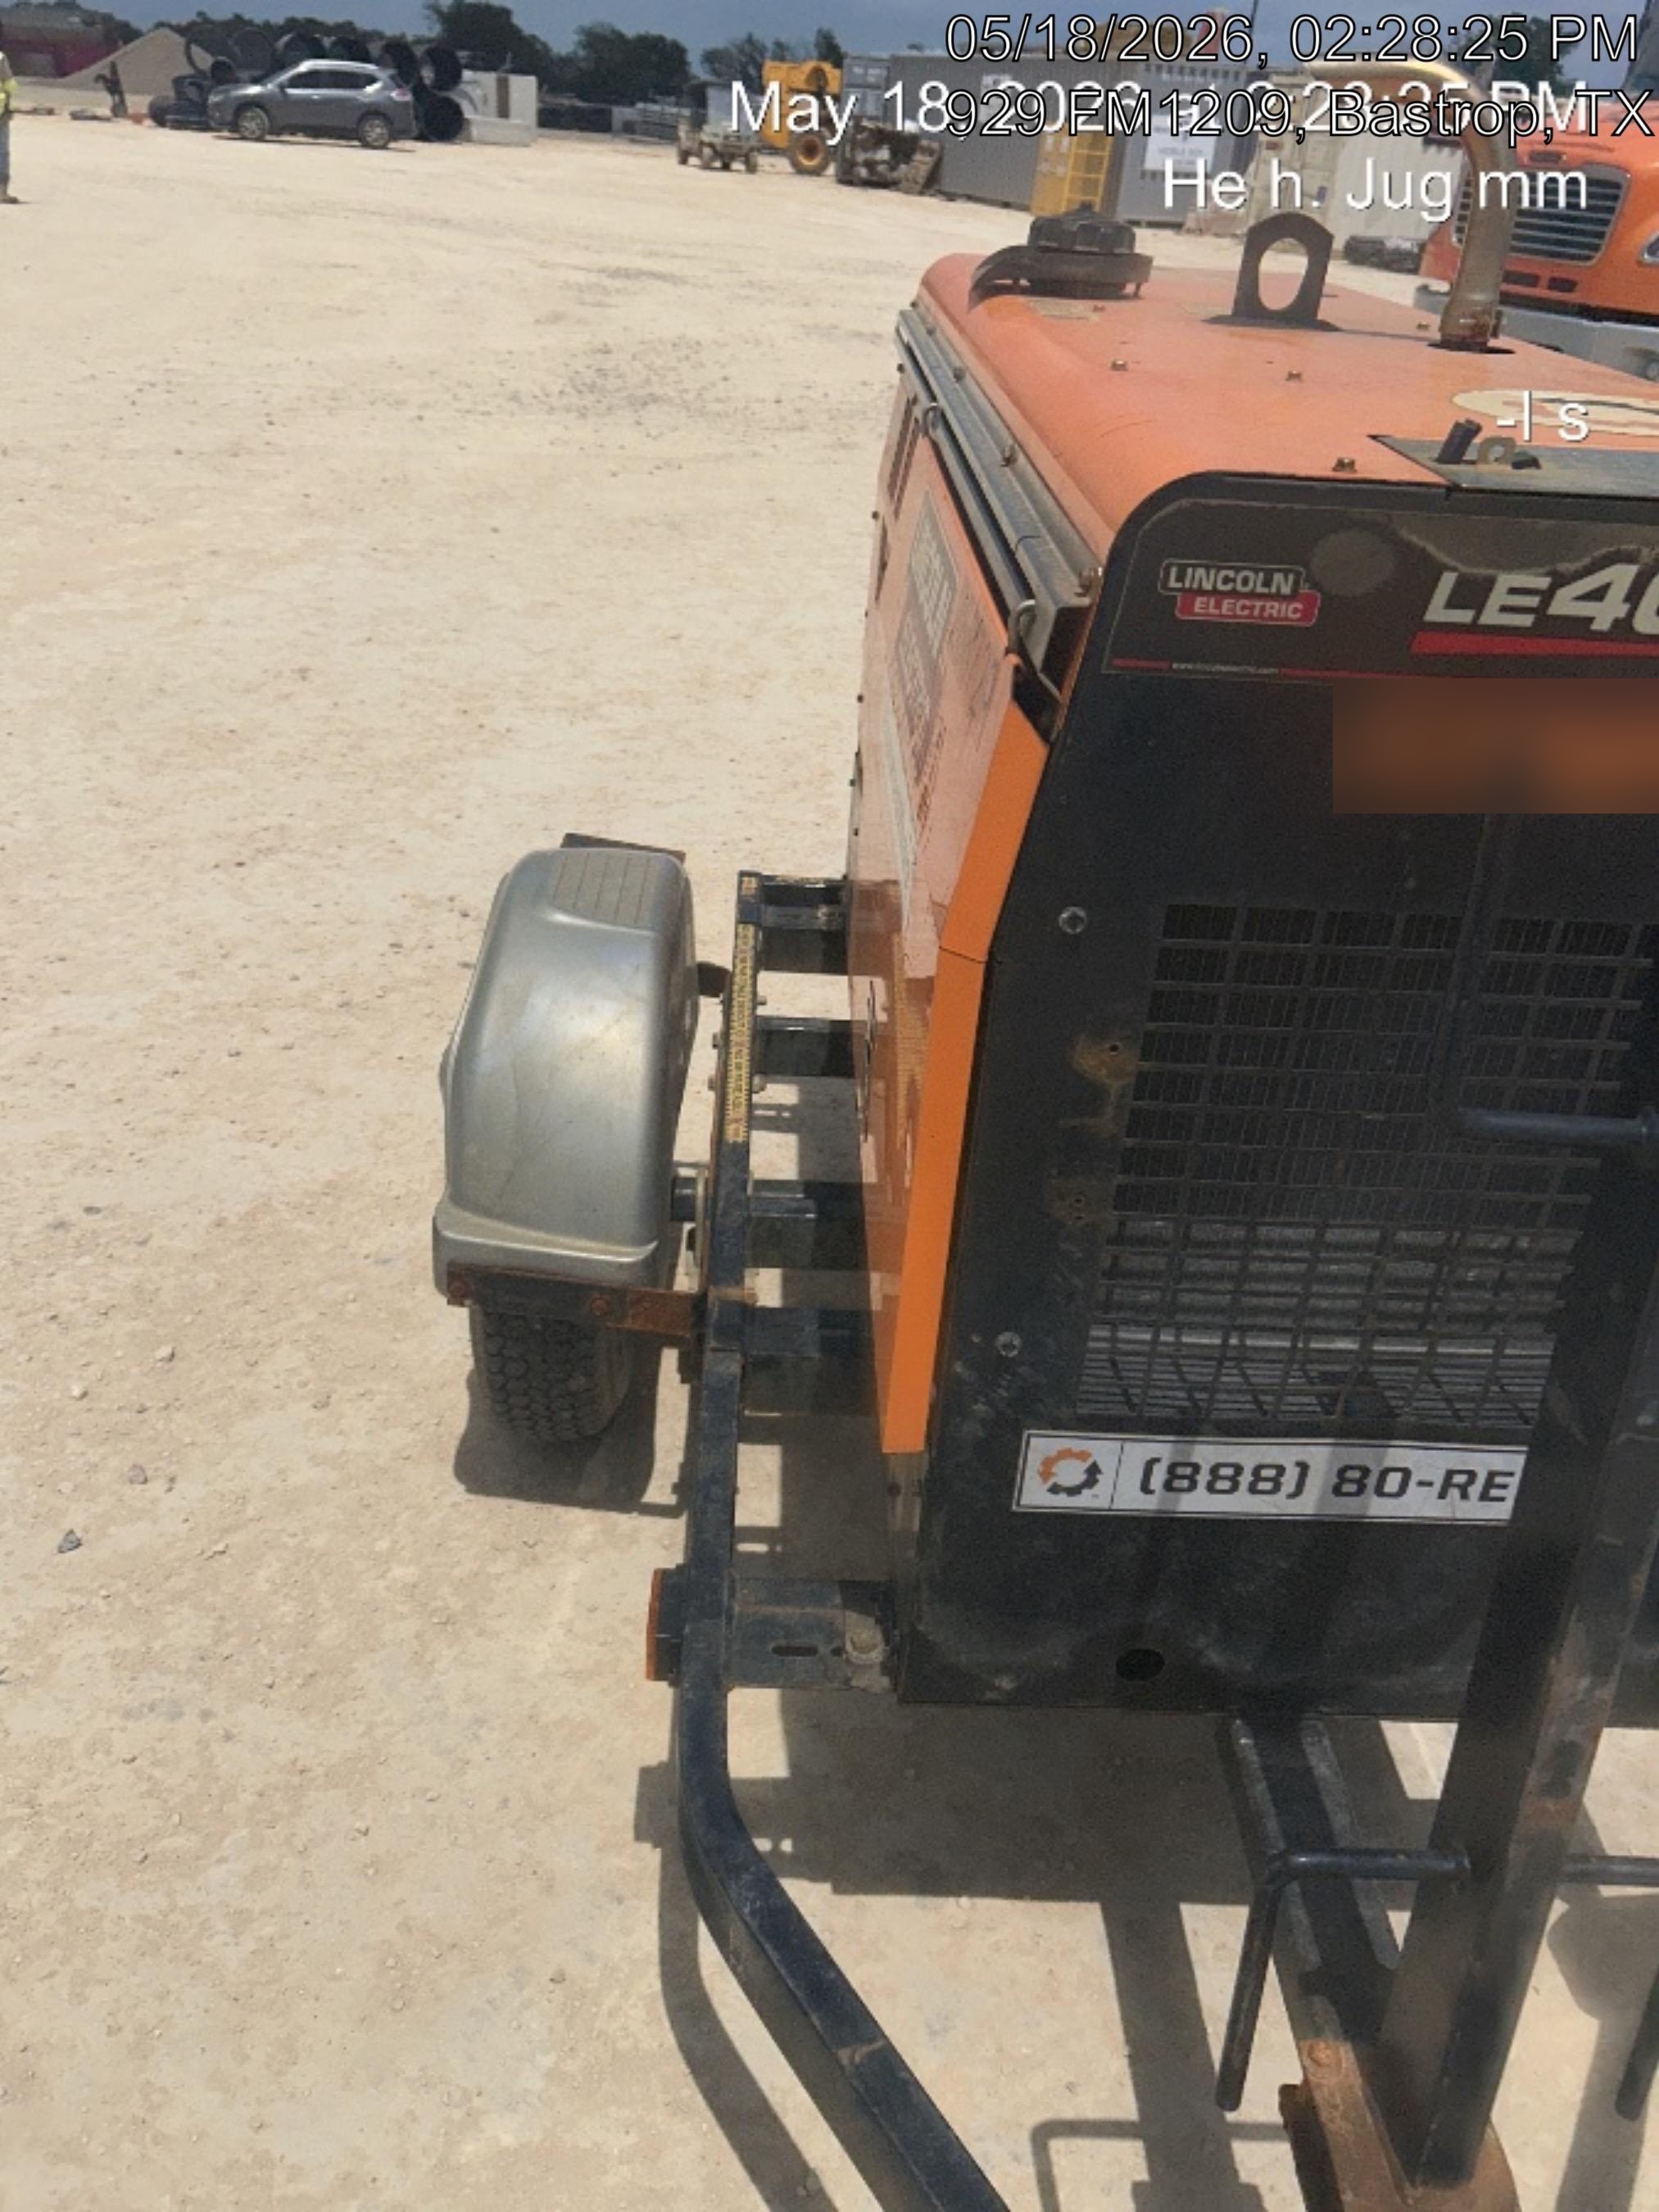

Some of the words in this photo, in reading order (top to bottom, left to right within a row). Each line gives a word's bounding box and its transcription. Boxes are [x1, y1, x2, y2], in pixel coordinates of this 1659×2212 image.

[1167, 565, 1295, 596] LINCOLN
[1193, 596, 1304, 619] ELECTRIC
[1139, 1457, 1310, 1500] (888)
[1330, 1463, 1516, 1503] 80-RE
